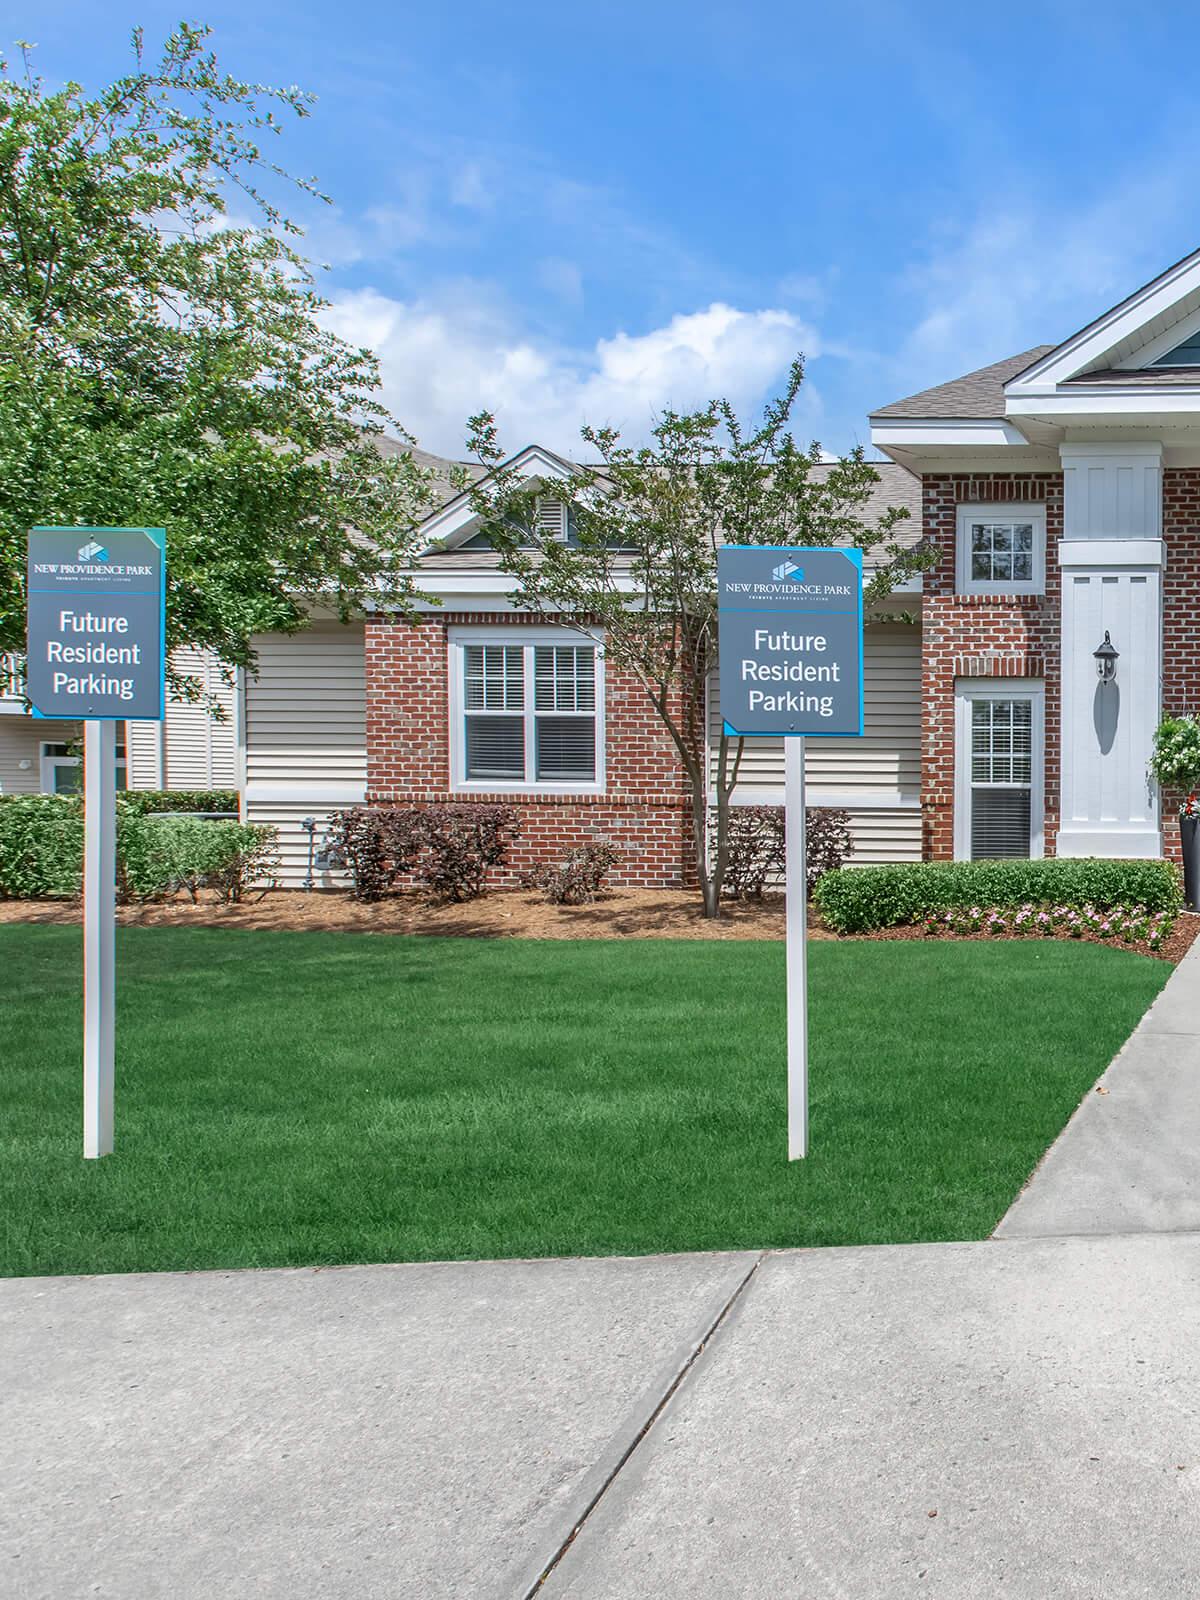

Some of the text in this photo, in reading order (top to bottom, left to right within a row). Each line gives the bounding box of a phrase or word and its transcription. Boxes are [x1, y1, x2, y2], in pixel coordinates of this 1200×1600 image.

[34, 564, 153, 576] NEW PROVIDENCE PARK
[725, 583, 851, 595] NEW PROVIDENCE PARK
[59, 610, 129, 633] Future
[754, 629, 827, 652] Future
[47, 641, 141, 665] Resident
[741, 659, 840, 683] Resident
[52, 671, 135, 700] Parking
[749, 690, 834, 717] Parking
